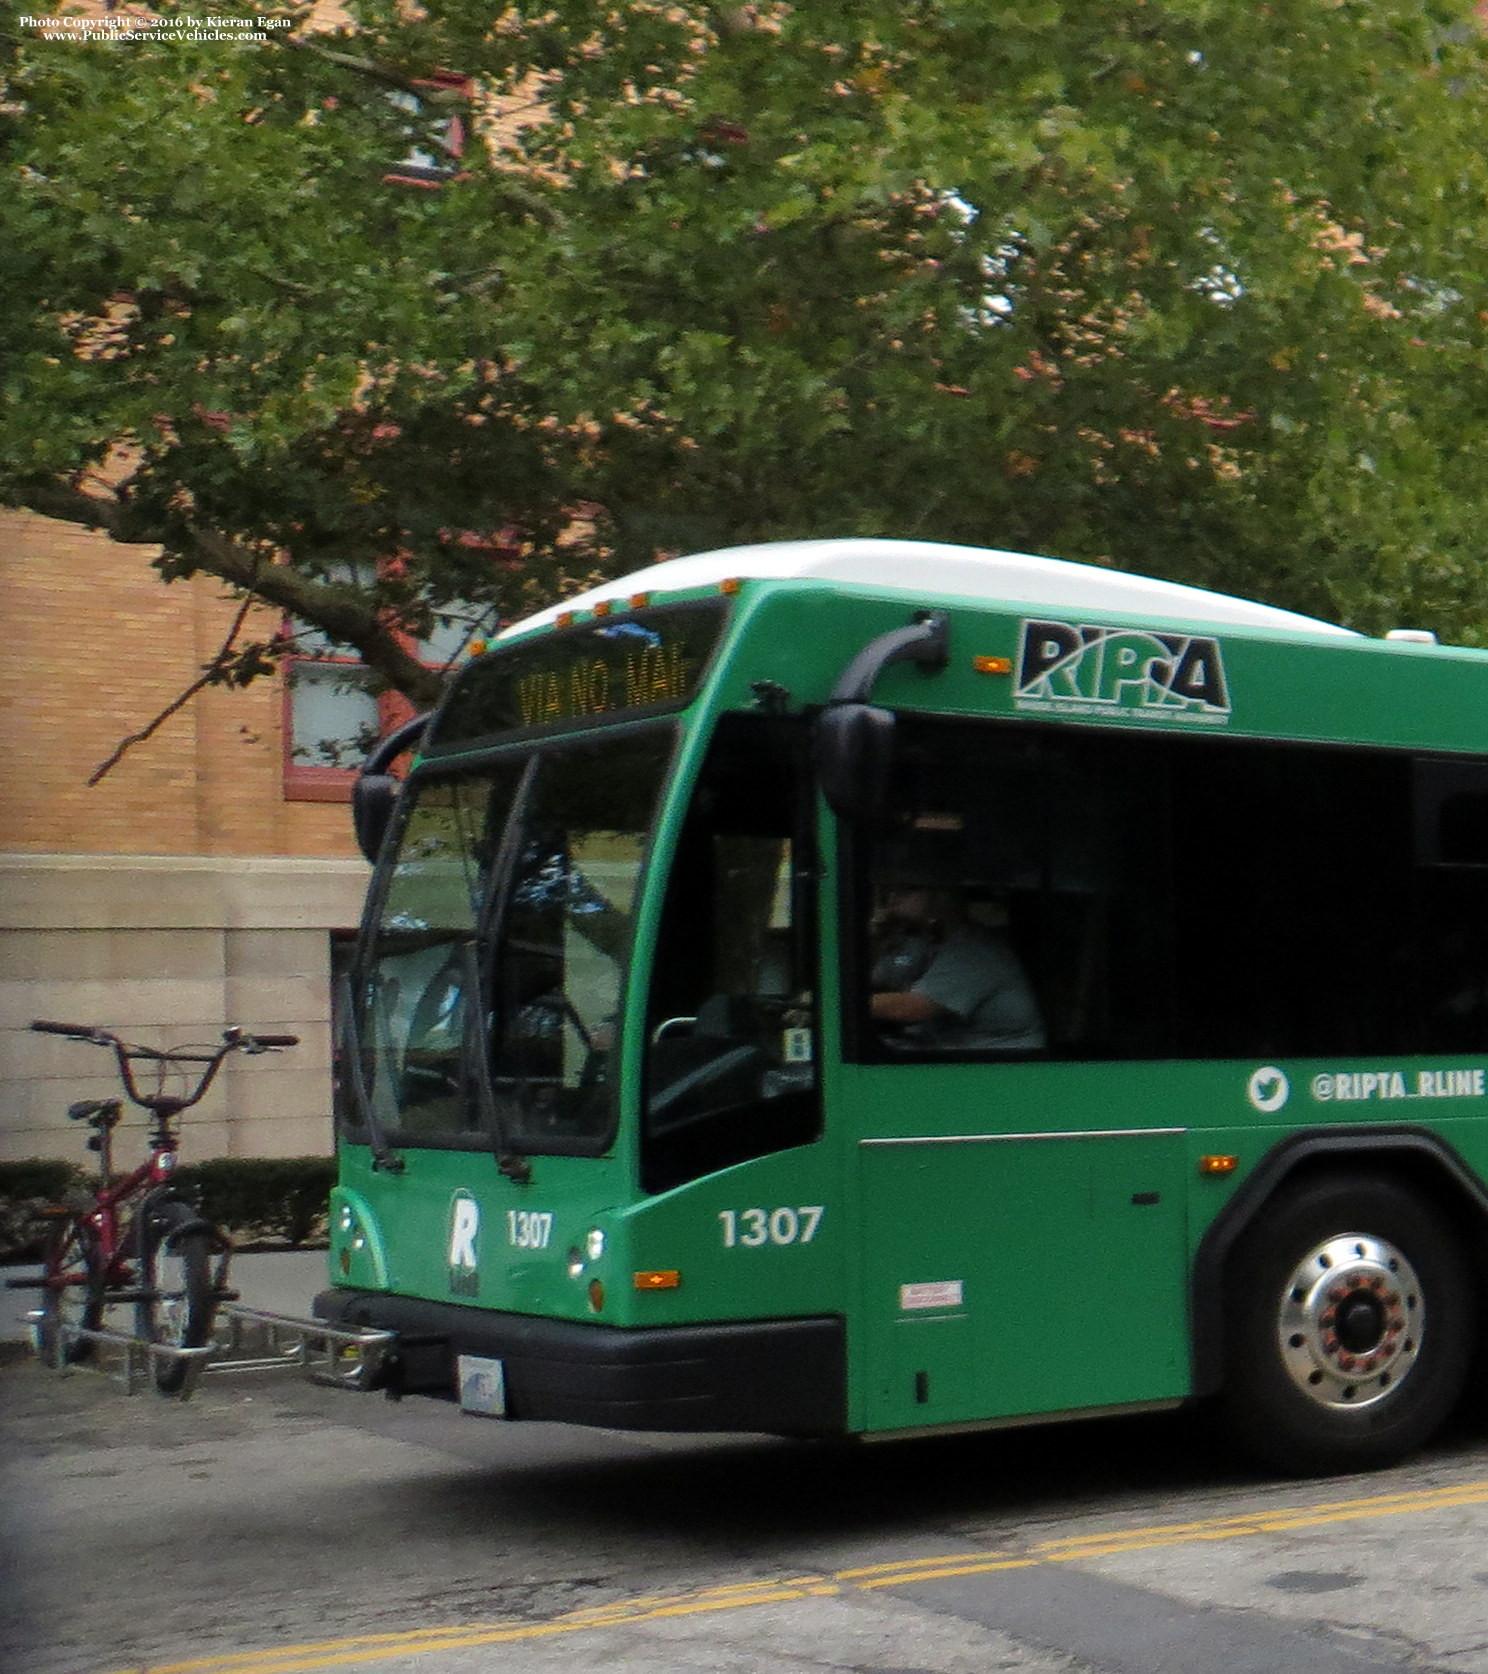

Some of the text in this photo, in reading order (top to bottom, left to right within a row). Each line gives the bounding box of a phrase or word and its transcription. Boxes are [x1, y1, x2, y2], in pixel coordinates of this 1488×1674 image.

[1014, 619, 1231, 713] RIPTA
[1312, 1069, 1485, 1099] @RIPTA_RLINE
[450, 1199, 478, 1267] R
[507, 1210, 553, 1248] 1307
[719, 1206, 824, 1247] 1307
